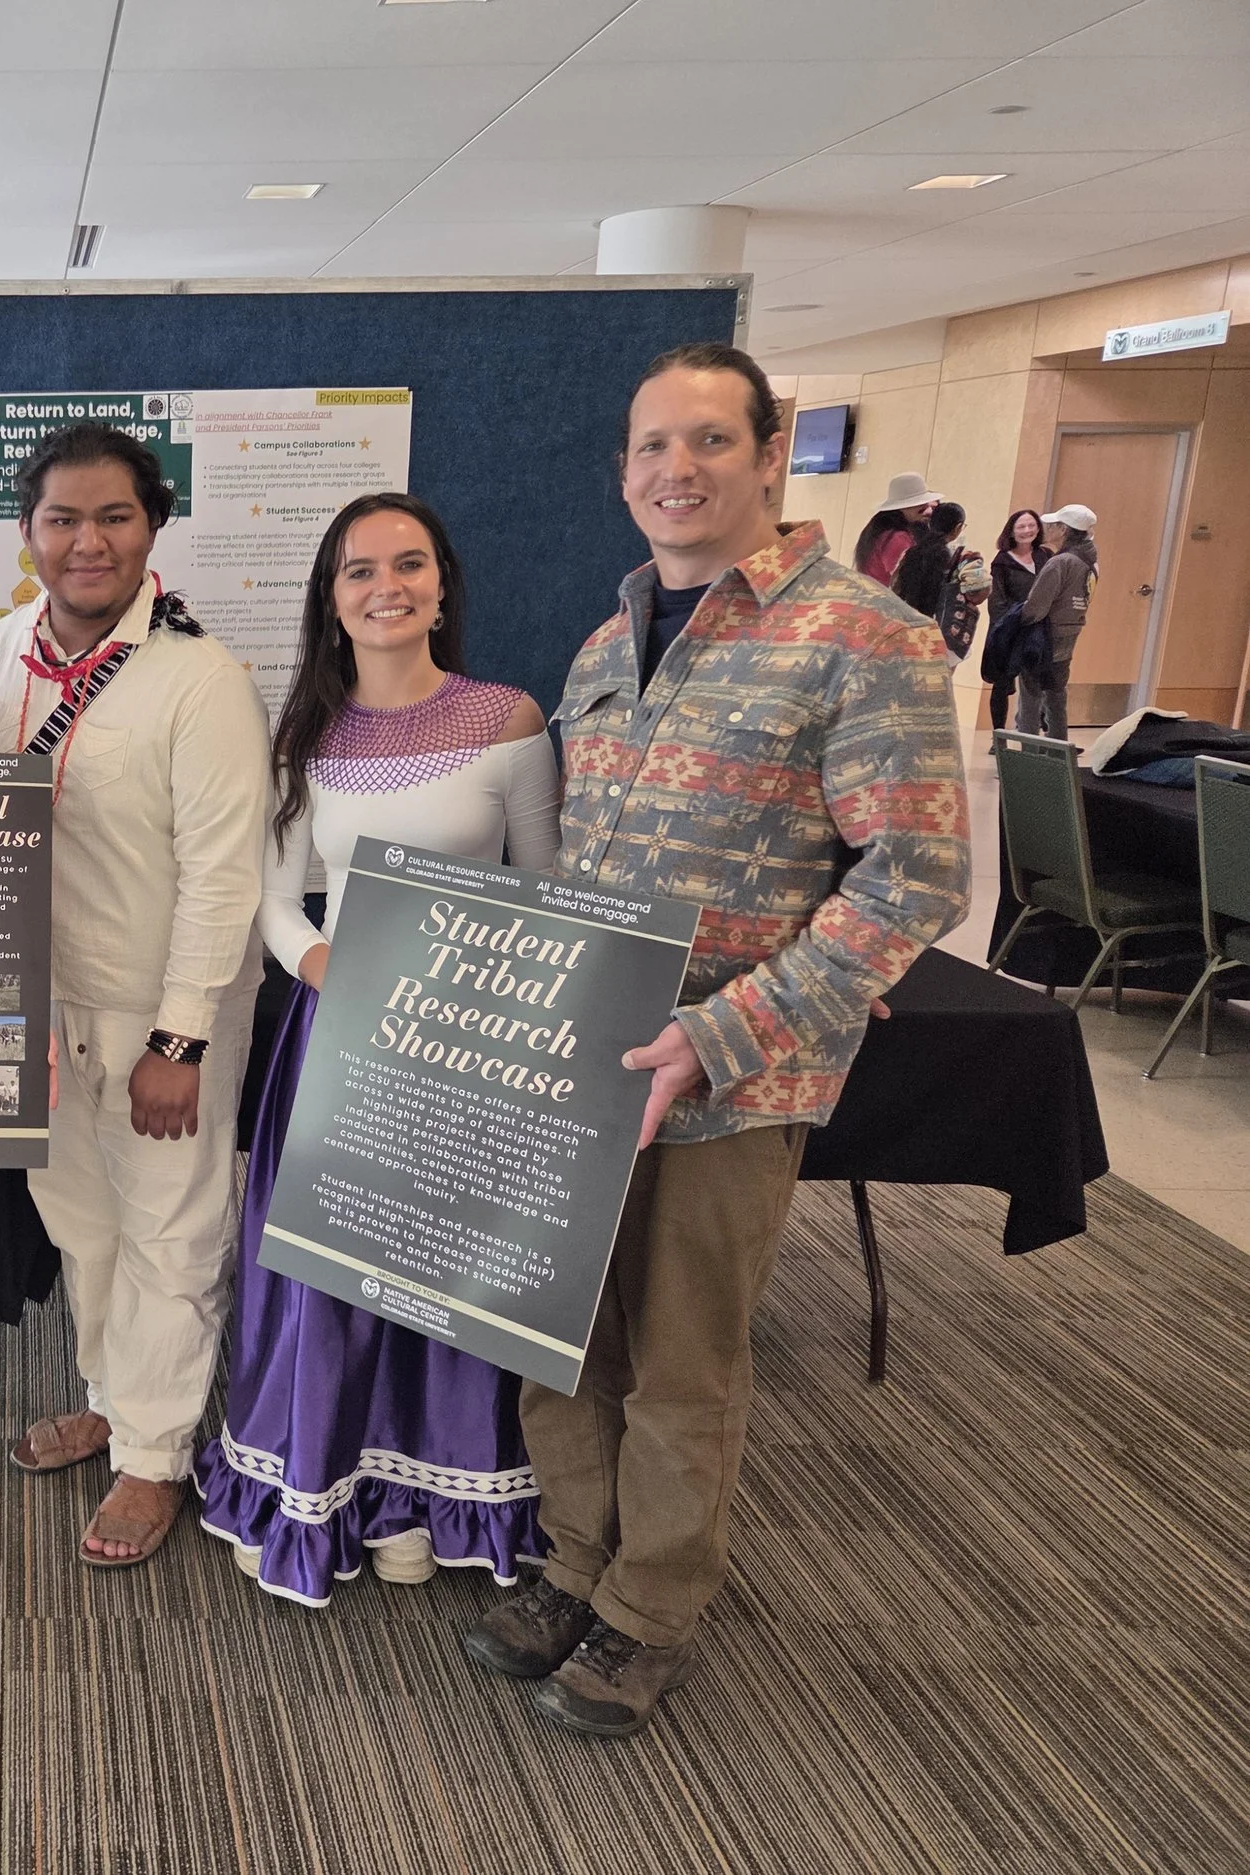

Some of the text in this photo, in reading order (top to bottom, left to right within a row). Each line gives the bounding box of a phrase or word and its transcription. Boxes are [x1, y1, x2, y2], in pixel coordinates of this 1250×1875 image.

[1133, 331, 1161, 347] Grand
[1162, 328, 1205, 343] Ballroom
[5, 401, 135, 419] Return to Land,
[319, 391, 409, 405] Priority Impacts
[213, 423, 250, 432] President
[266, 411, 309, 419] Chancellor
[311, 410, 333, 418] Frank
[254, 440, 355, 451] Campus Collaborations
[266, 506, 335, 515] Student Success
[256, 580, 302, 589] Advancing
[258, 663, 278, 671] Land
[0, 758, 18, 767] and
[406, 867, 484, 888] COLORADO STATE UNIVERSITY
[408, 856, 521, 887] CULTURAL RESOURCE CENTERS
[536, 881, 651, 913] All are welcome and
[541, 893, 638, 924] invited to engage.
[418, 900, 586, 969] Student
[424, 942, 567, 1009] Tribal
[383, 975, 577, 1058] Research
[370, 1014, 574, 1102] Showcase
[340, 1050, 598, 1138] This research showcase offers a platform
[348, 1066, 579, 1146] for CSU students to present research
[345, 1080, 382, 1097] across
[398, 1096, 425, 1110] wide
[430, 1107, 465, 1123] range
[469, 1119, 482, 1128] of
[486, 1124, 561, 1155] disciplines.
[567, 1149, 576, 1160] It
[363, 1097, 548, 1166] highlights projects shaped by
[376, 1270, 411, 1288] BROUGHT
[411, 1284, 422, 1292] TO
[423, 1288, 438, 1299] YOU
[382, 1294, 448, 1326] CULTURAL CENTER
[384, 1287, 450, 1319] NATIVE AMERICAN
